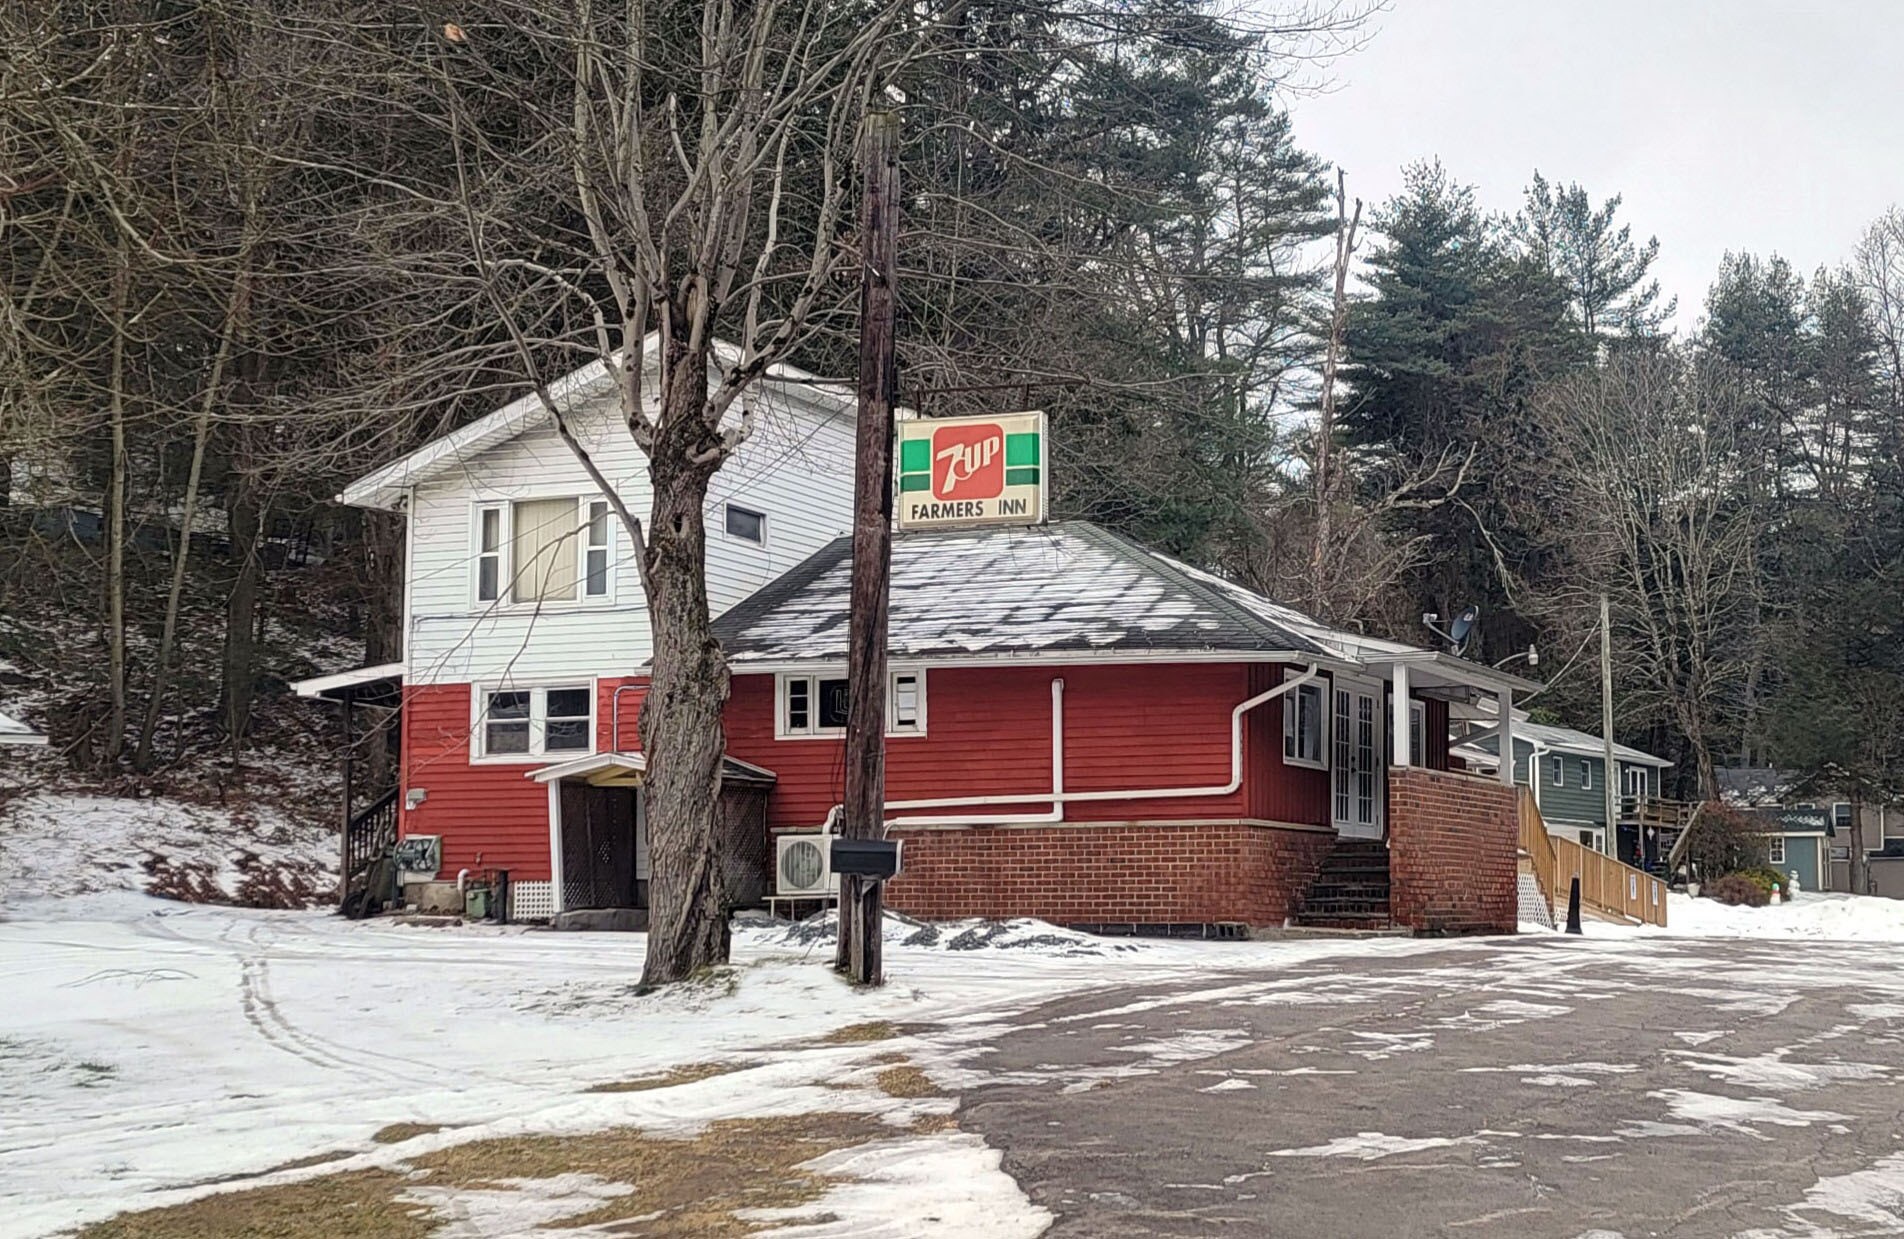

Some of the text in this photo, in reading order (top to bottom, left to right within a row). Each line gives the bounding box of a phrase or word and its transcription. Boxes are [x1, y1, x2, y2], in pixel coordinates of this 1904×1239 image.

[936, 436, 1000, 495] 7UP
[911, 498, 1027, 520] FARMERS INN
